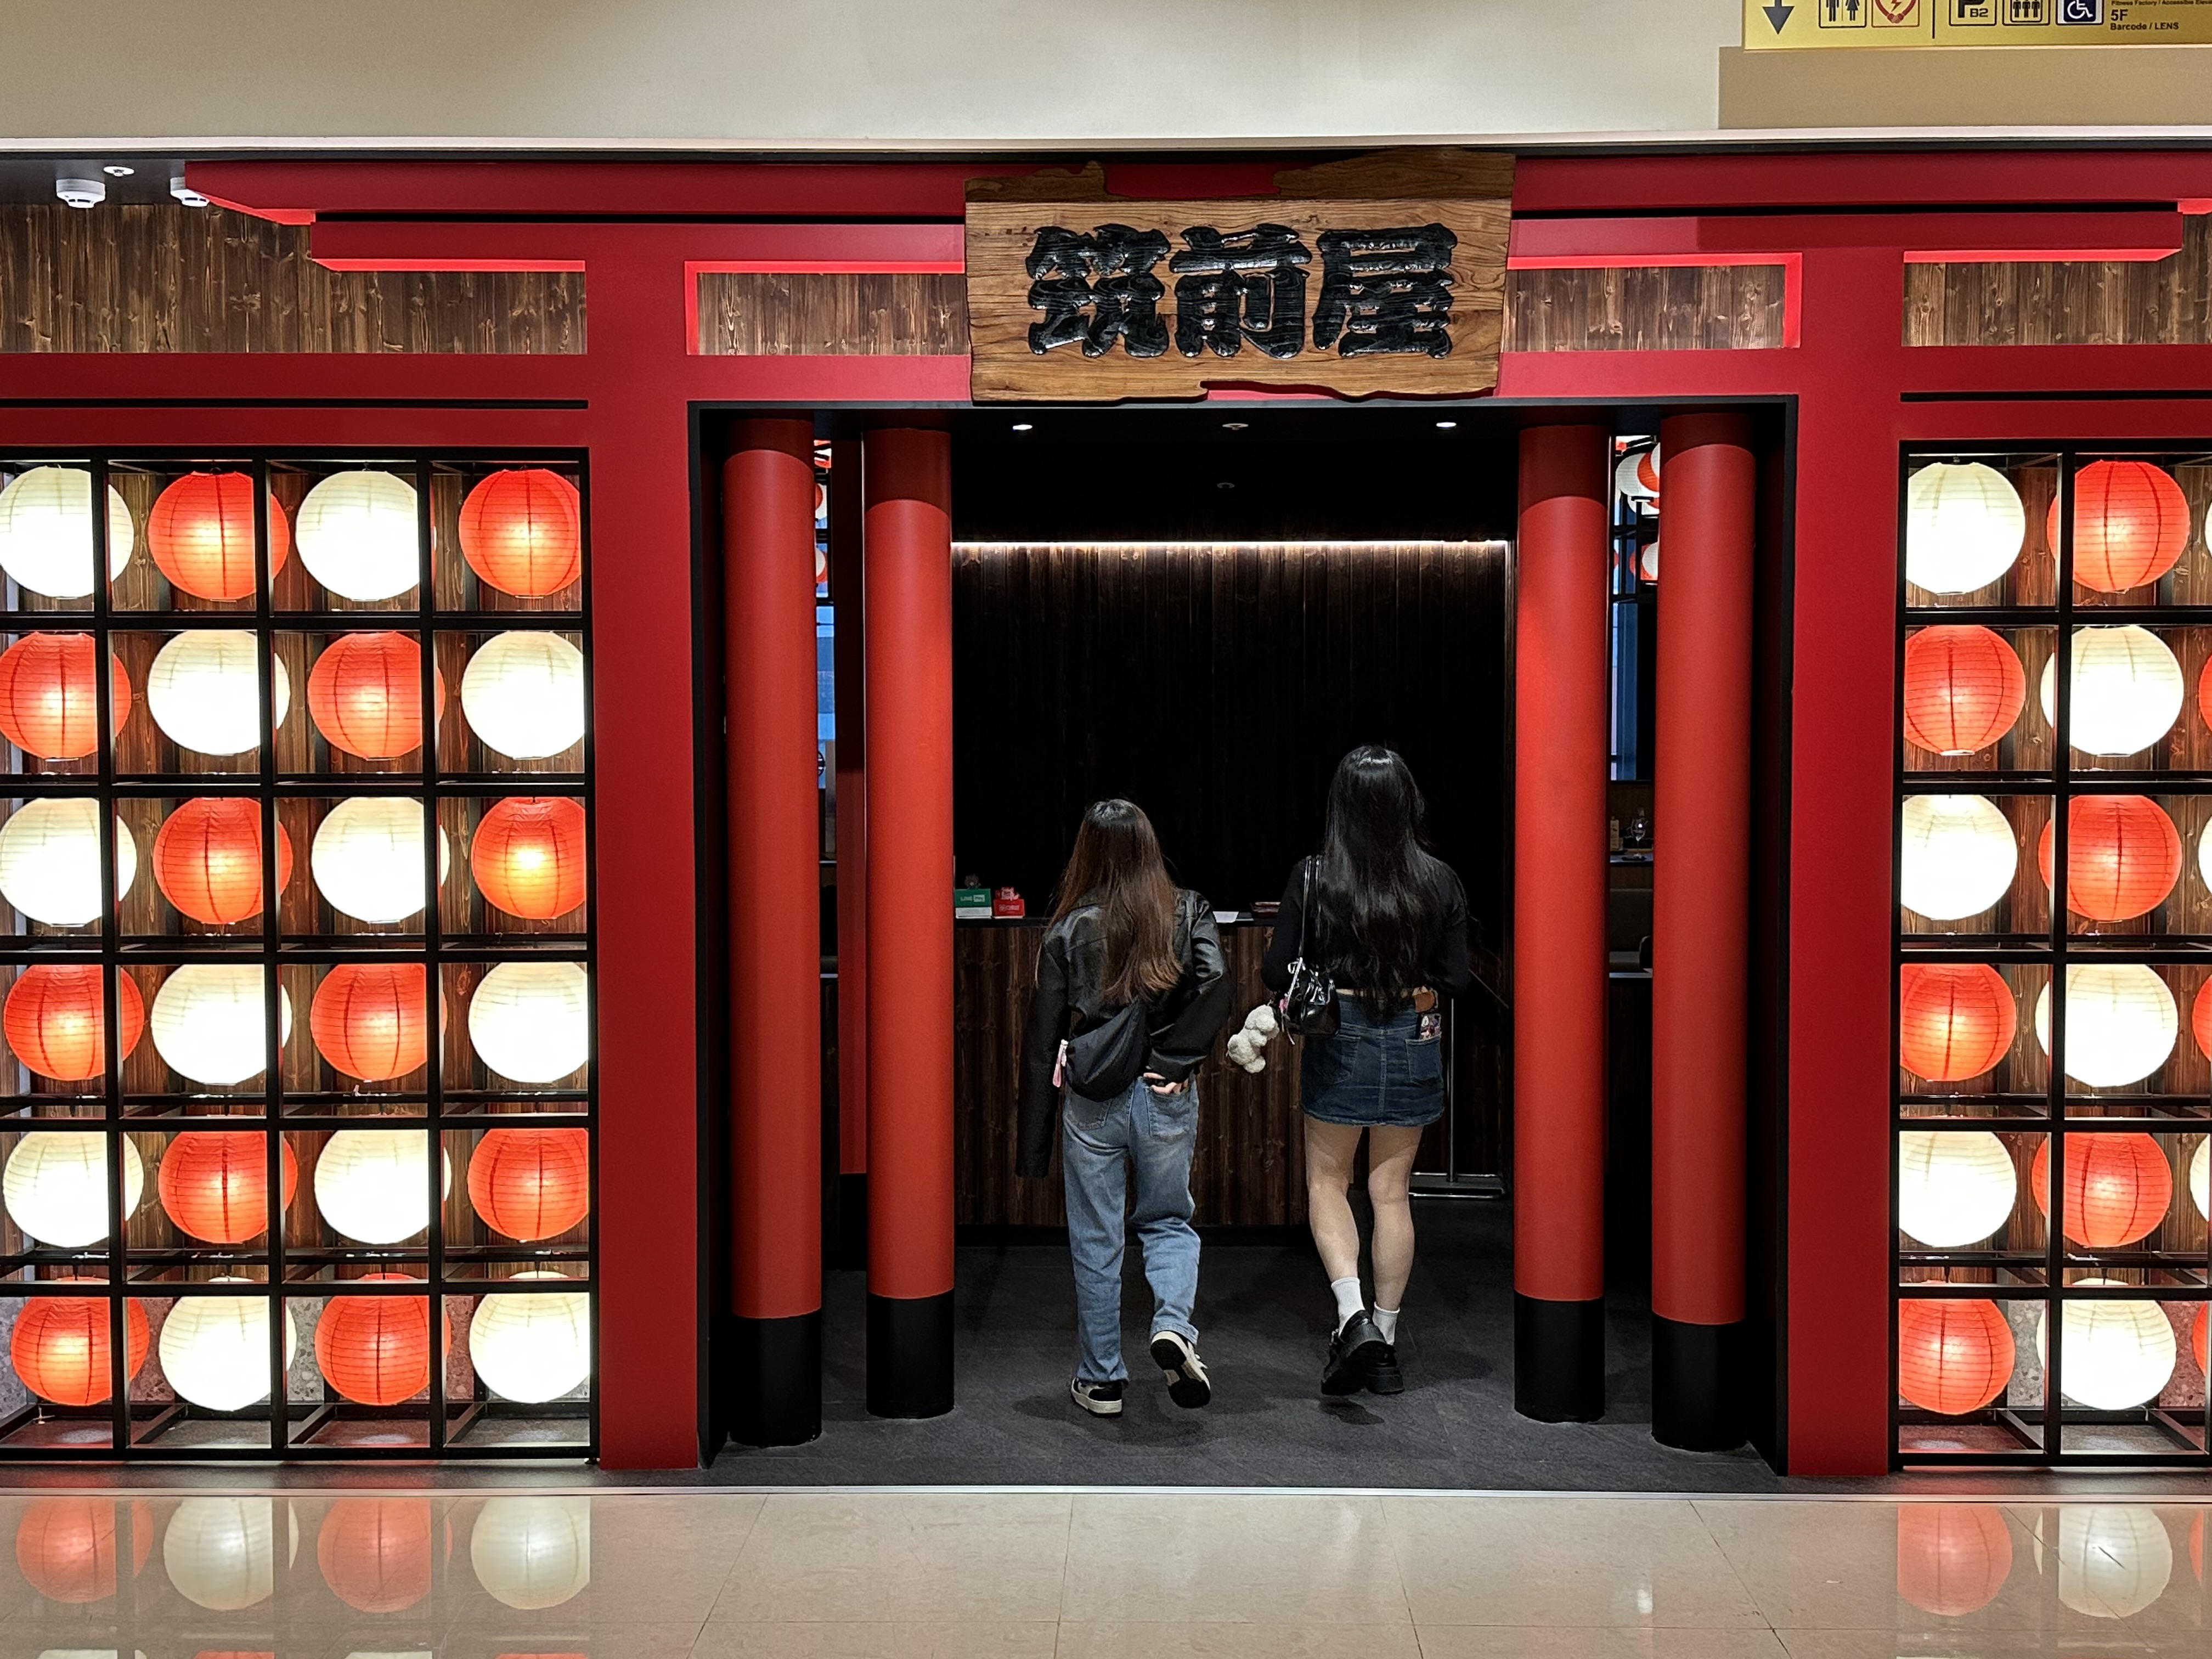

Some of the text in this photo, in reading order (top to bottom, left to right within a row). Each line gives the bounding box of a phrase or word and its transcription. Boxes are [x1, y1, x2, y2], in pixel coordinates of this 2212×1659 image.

[1970, 8, 1988, 18] B2
[2111, 9, 2129, 21] 5F
[1026, 222, 1458, 358] 筑前屋
